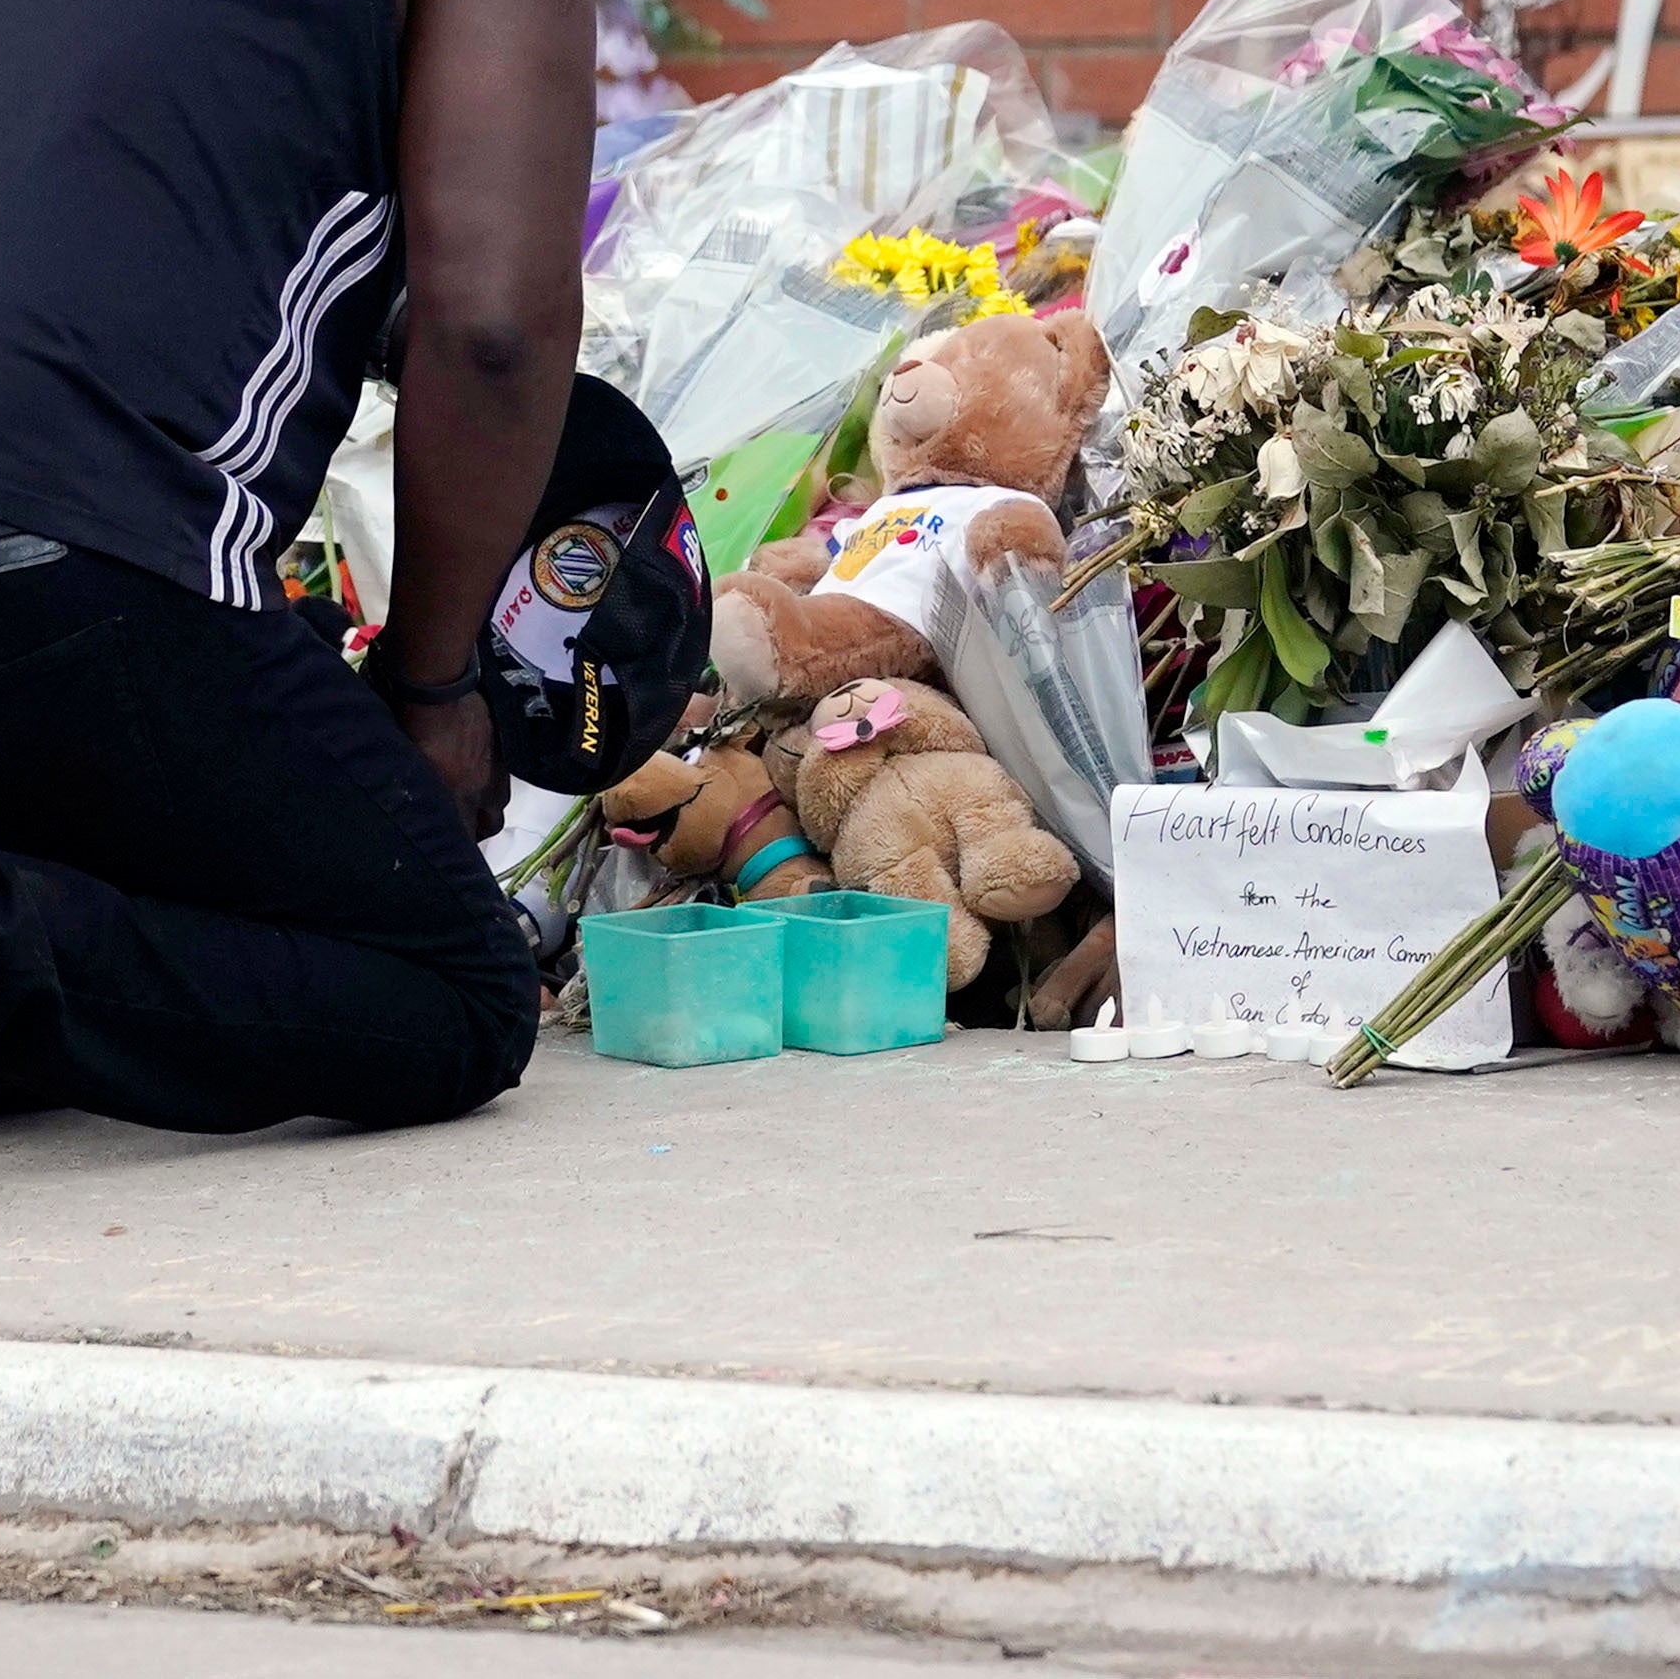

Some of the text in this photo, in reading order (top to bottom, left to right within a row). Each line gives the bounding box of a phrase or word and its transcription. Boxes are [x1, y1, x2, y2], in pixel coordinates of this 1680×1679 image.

[581, 660, 600, 754] VETERAN
[1123, 787, 1428, 857] Heartfelt Condolences
[1239, 880, 1339, 910] from the
[1289, 970, 1312, 1000] of
[1229, 992, 1265, 1021] San
